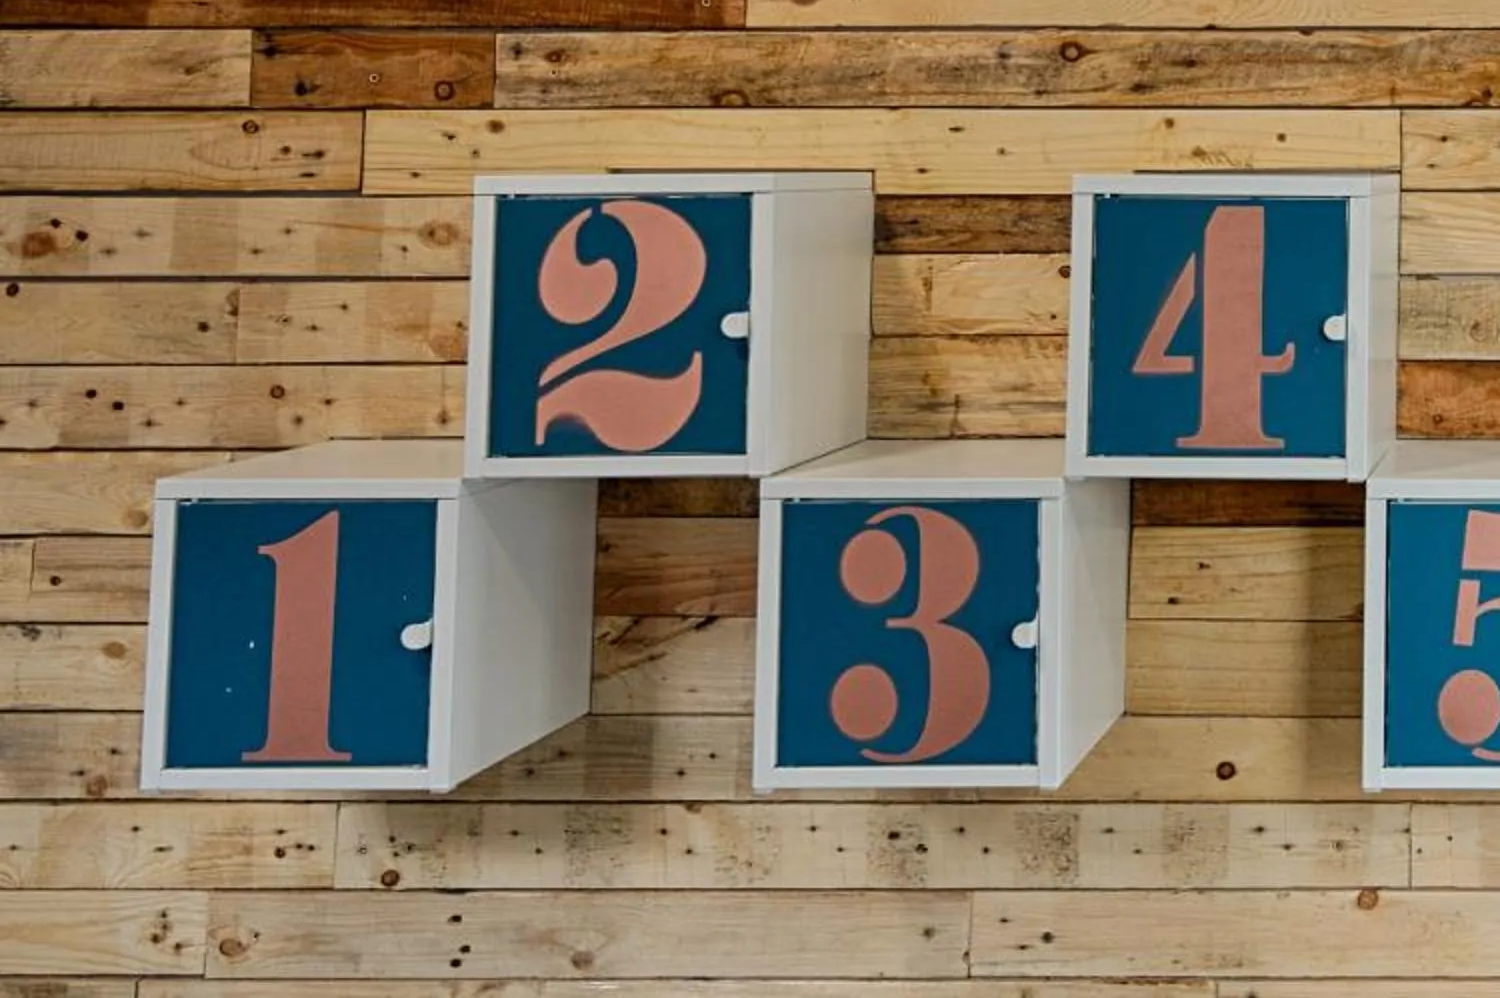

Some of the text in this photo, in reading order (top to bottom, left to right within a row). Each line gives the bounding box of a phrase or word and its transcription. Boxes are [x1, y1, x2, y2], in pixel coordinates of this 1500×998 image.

[535, 199, 707, 452] 2
[1132, 205, 1295, 449] 4
[241, 510, 352, 762] 1
[829, 505, 991, 763] 3
